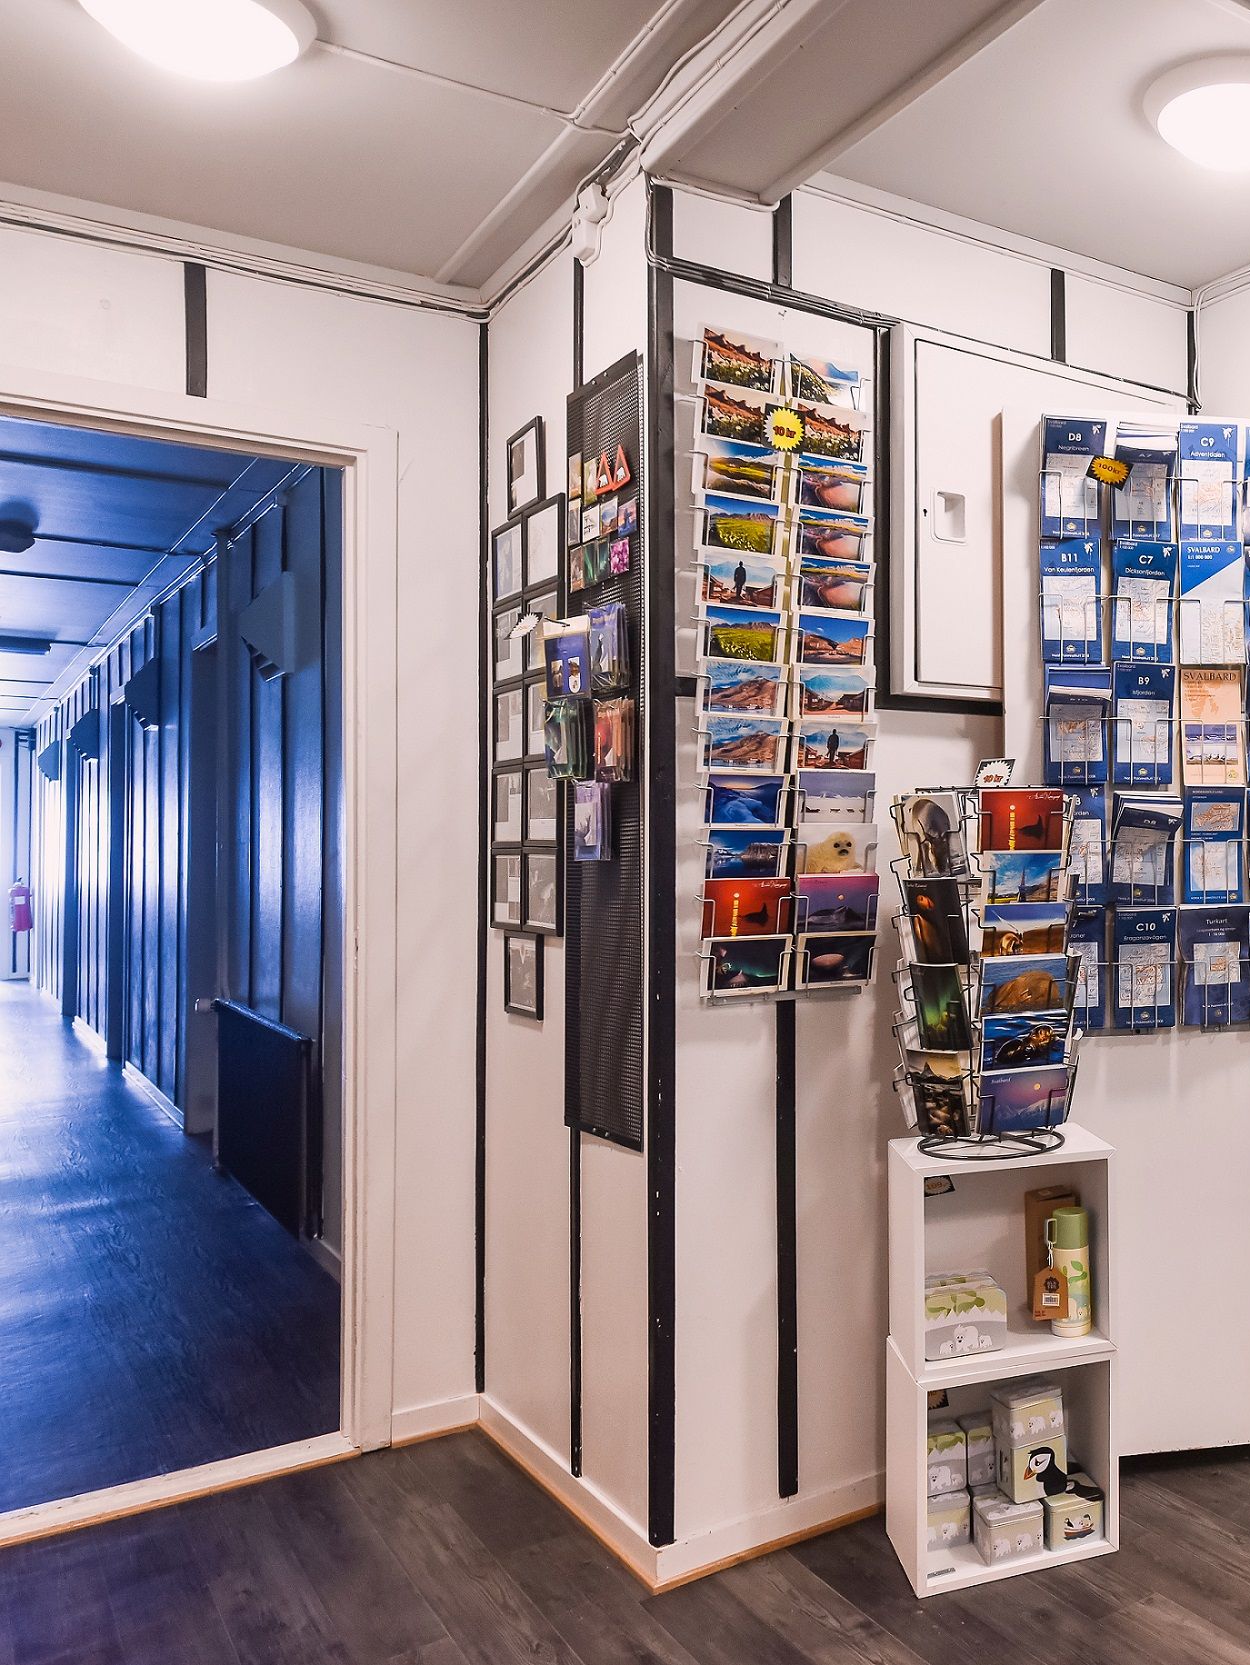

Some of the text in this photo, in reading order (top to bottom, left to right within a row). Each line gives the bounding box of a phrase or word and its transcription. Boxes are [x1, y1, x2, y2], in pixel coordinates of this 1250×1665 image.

[1068, 432, 1082, 442] D8
[1200, 437, 1215, 447] C9
[1187, 546, 1221, 554] SVALBARD
[1061, 552, 1078, 563] B11
[1139, 554, 1154, 565] C7
[1138, 676, 1150, 685] B9
[1183, 672, 1237, 681] SVALBARD
[1136, 922, 1156, 931] C10
